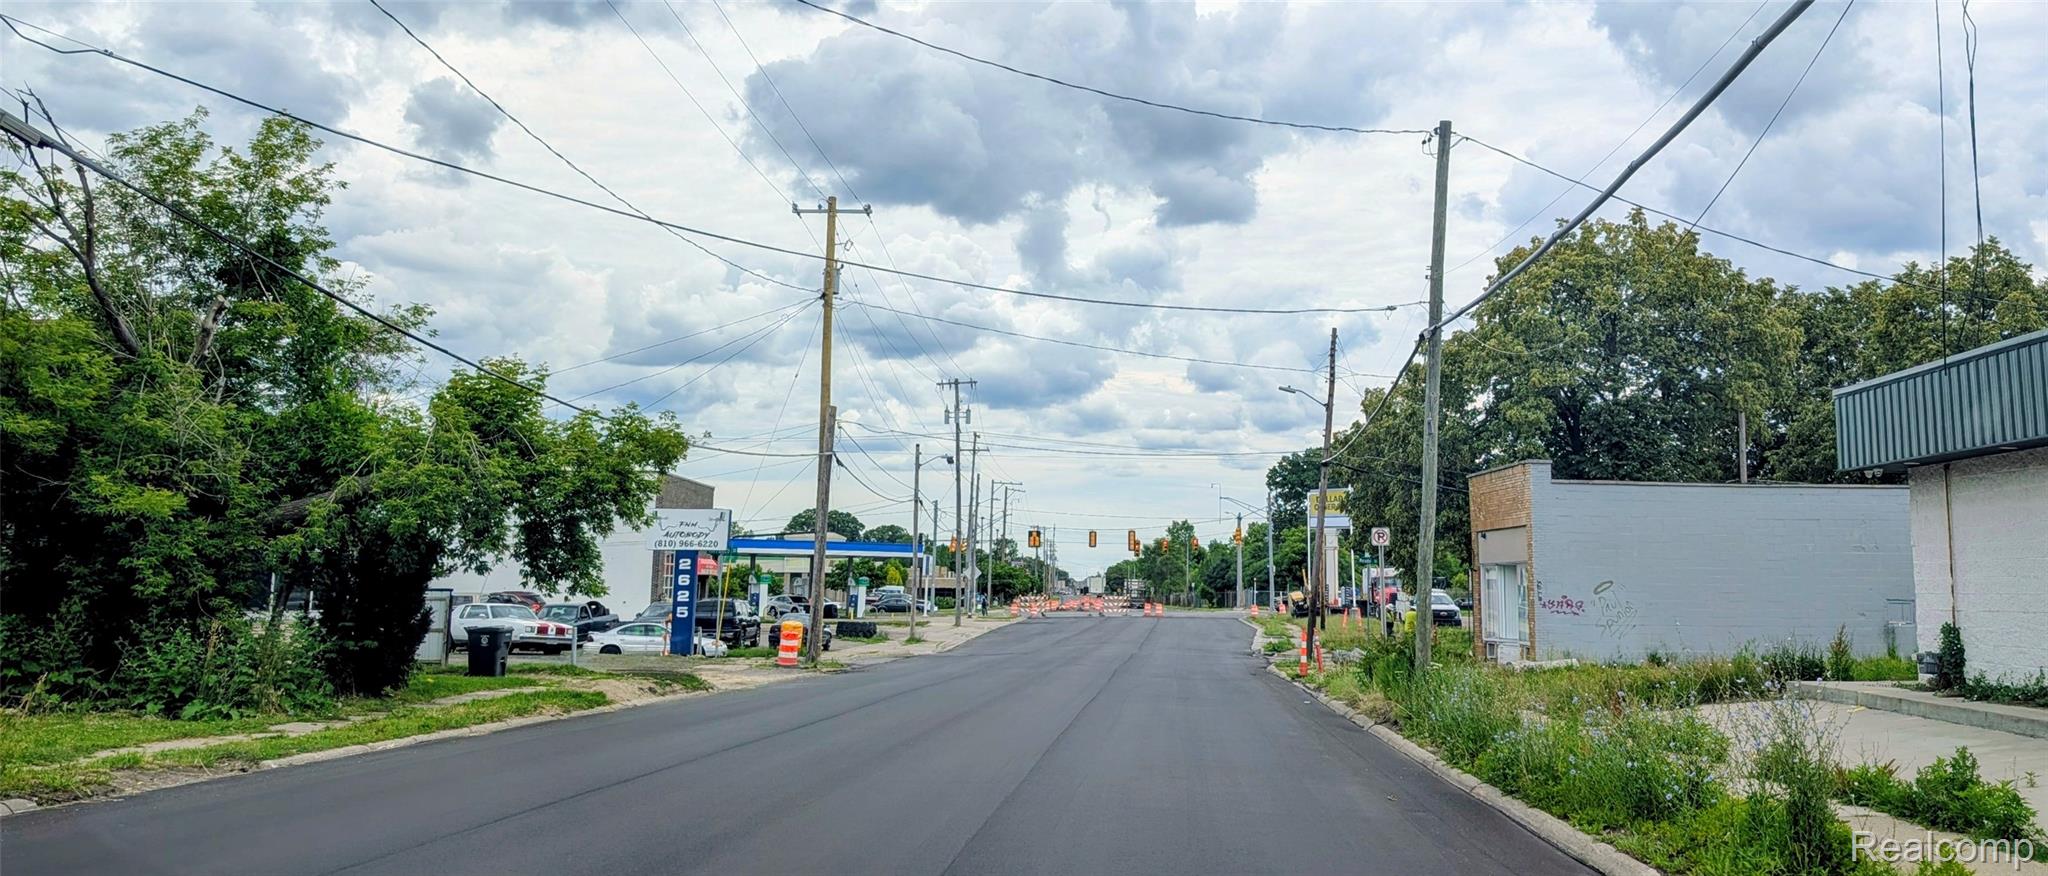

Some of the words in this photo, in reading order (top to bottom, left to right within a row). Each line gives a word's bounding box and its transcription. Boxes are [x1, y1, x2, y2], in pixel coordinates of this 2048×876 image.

[654, 540, 677, 548] (810)
[679, 540, 719, 548] 966-6220
[676, 558, 692, 618] 2625
